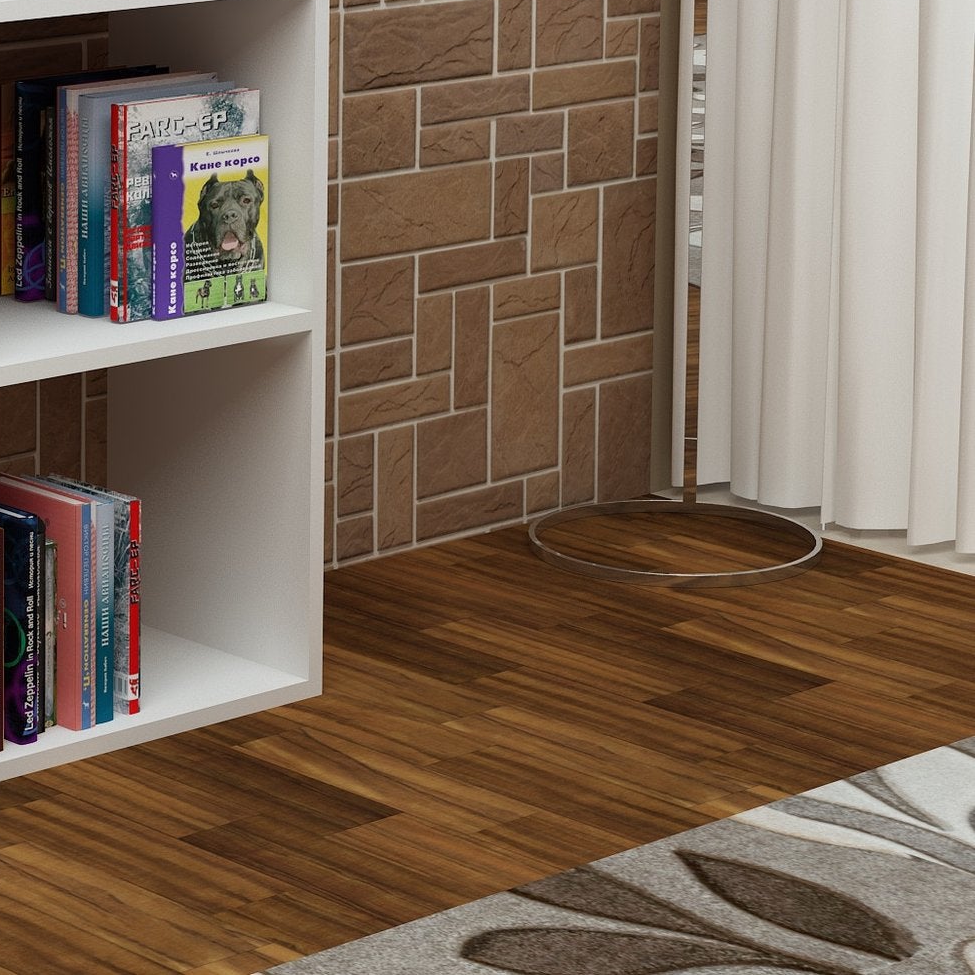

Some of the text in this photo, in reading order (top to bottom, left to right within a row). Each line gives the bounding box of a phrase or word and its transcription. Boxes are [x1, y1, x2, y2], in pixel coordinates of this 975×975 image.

[127, 110, 229, 142] FARC-EP
[190, 155, 261, 172] Кане корсо
[15, 223, 24, 266] Zeppelin
[15, 267, 23, 287] Led
[168, 242, 178, 314] Кане корсо
[129, 541, 140, 605] FARC-EP
[102, 607, 110, 646] НАШИ
[24, 595, 35, 731] Led Zeppelin in Rock and Roll
